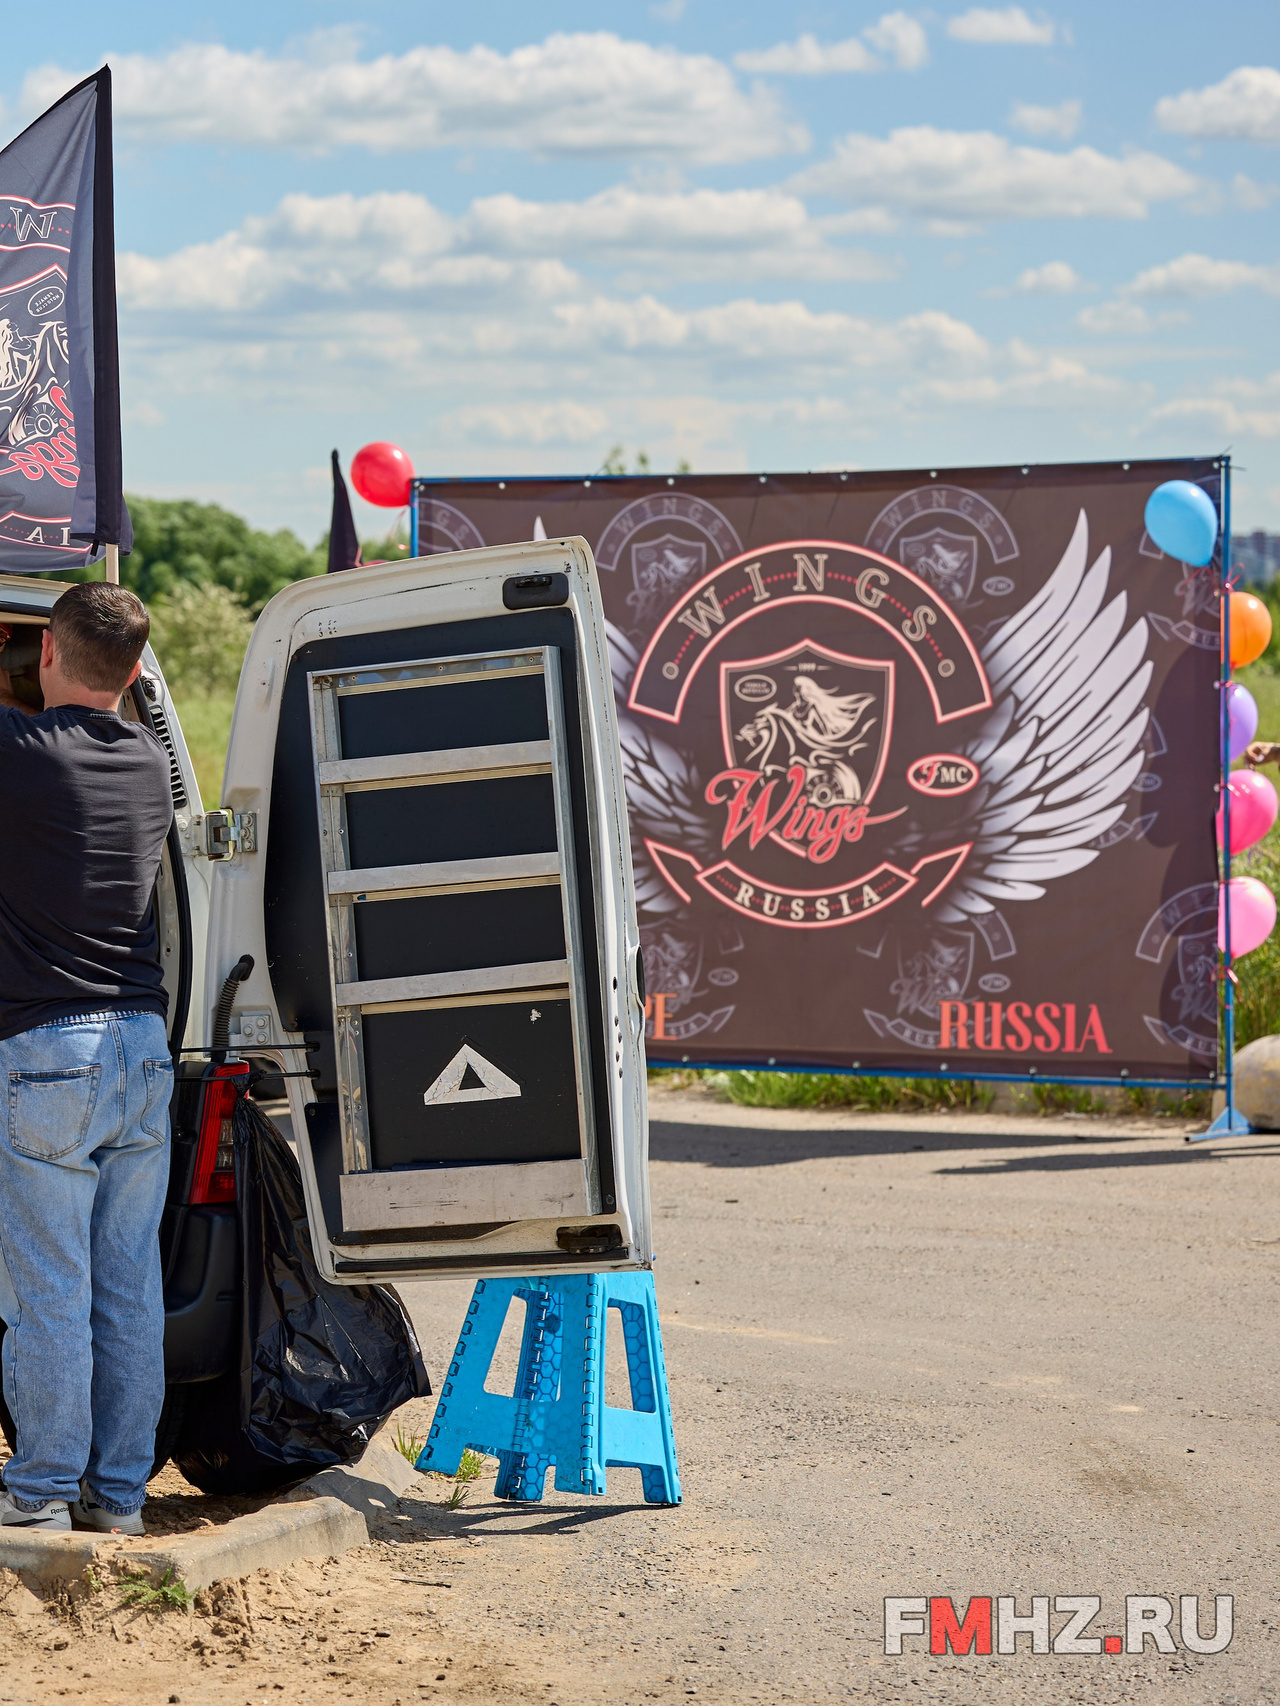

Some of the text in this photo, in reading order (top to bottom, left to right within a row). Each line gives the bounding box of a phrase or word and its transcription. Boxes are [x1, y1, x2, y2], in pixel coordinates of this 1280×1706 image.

[676, 553, 938, 642] WINGS
[704, 764, 909, 864] Wings
[734, 880, 882, 921] RUSSIA
[937, 1000, 1114, 1054] RUSSIA
